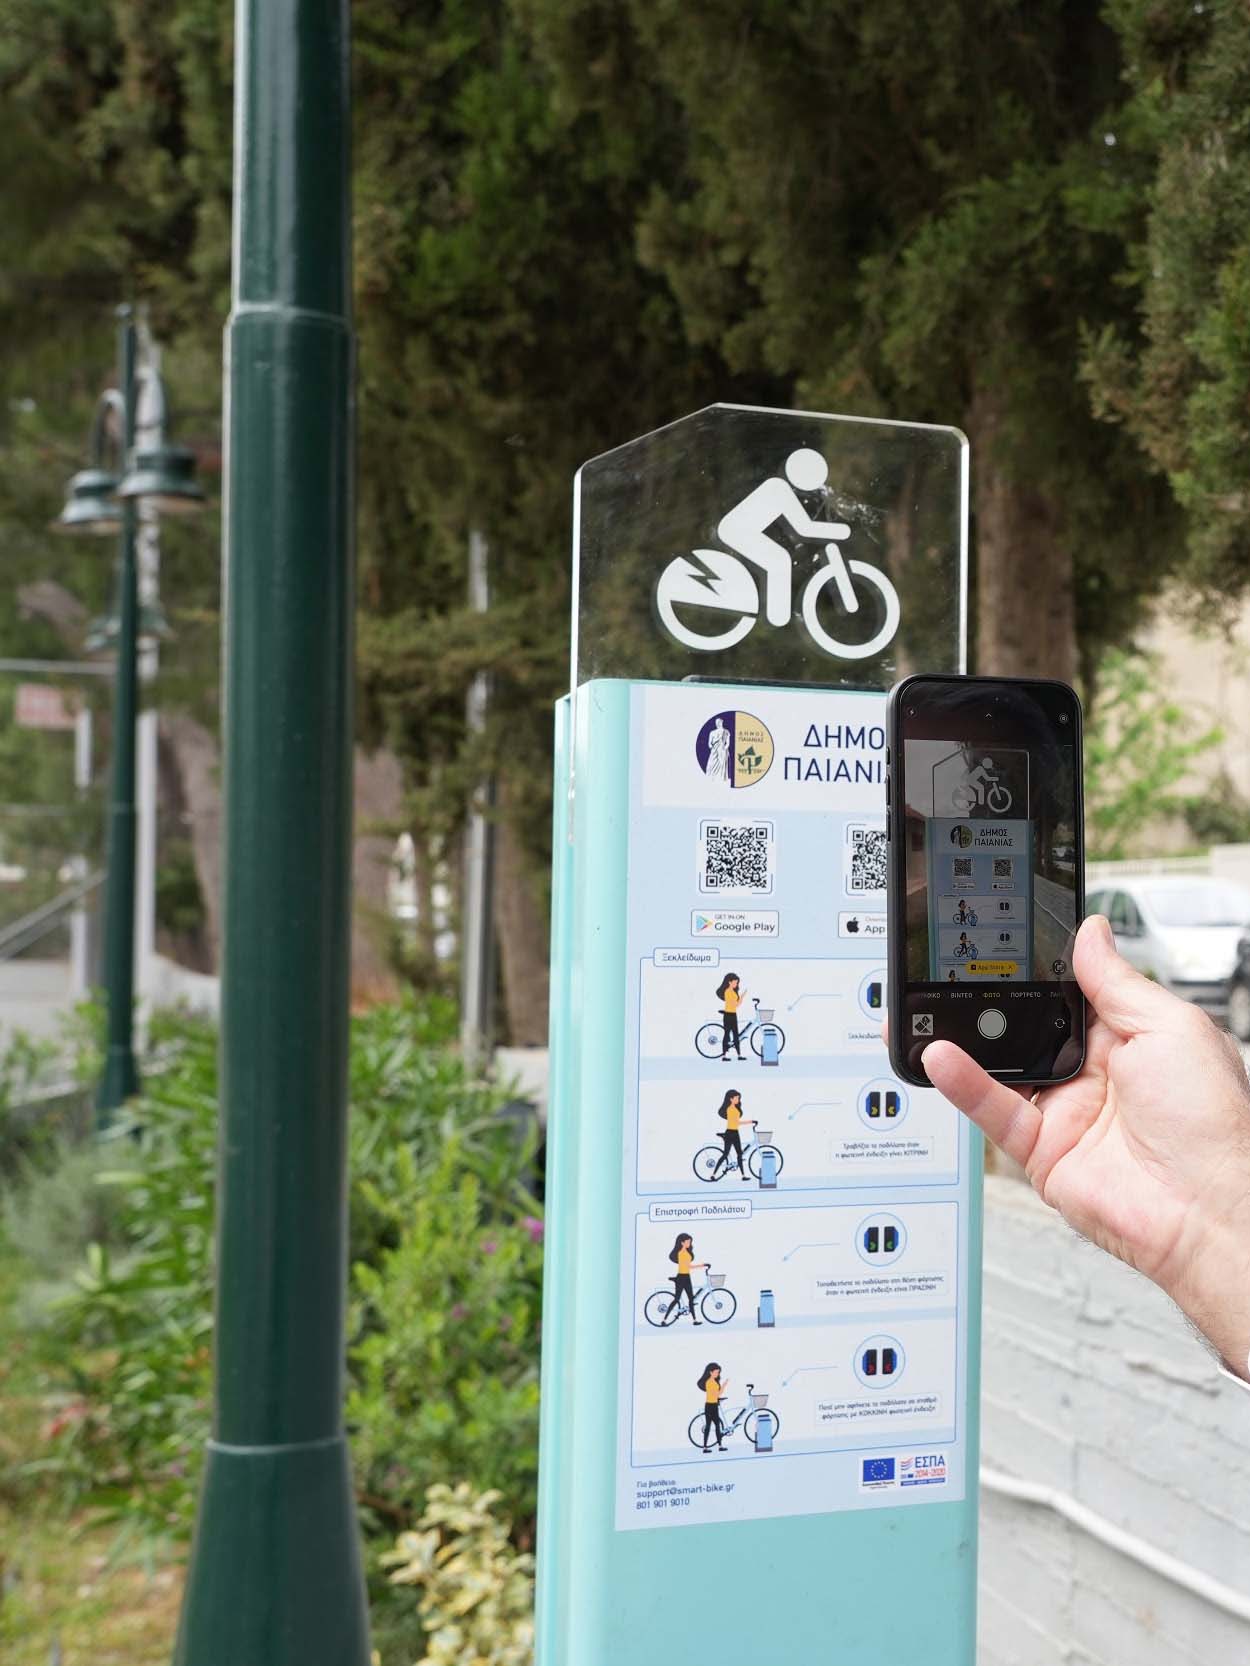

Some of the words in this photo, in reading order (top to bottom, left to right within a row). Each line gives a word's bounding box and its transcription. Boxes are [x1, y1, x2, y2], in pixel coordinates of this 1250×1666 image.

[803, 724, 886, 750] ΔΗΜΟ
[784, 756, 887, 784] ΠΑΙΑΝΙ
[974, 838, 1014, 847] ΠΑΙΑΝΙΑΣ
[714, 922, 751, 933] Google
[754, 922, 776, 933] Play
[864, 924, 886, 935] App
[655, 1206, 699, 1217] Επιστροφή
[701, 1204, 746, 1215] Ποδηλάτου
[915, 1455, 946, 1468] ΕΣΠΑ
[636, 1483, 735, 1499] support@smart-bike.gr
[636, 1500, 651, 1510] 801
[653, 1499, 668, 1509] 901
[670, 1497, 690, 1507] 9010
